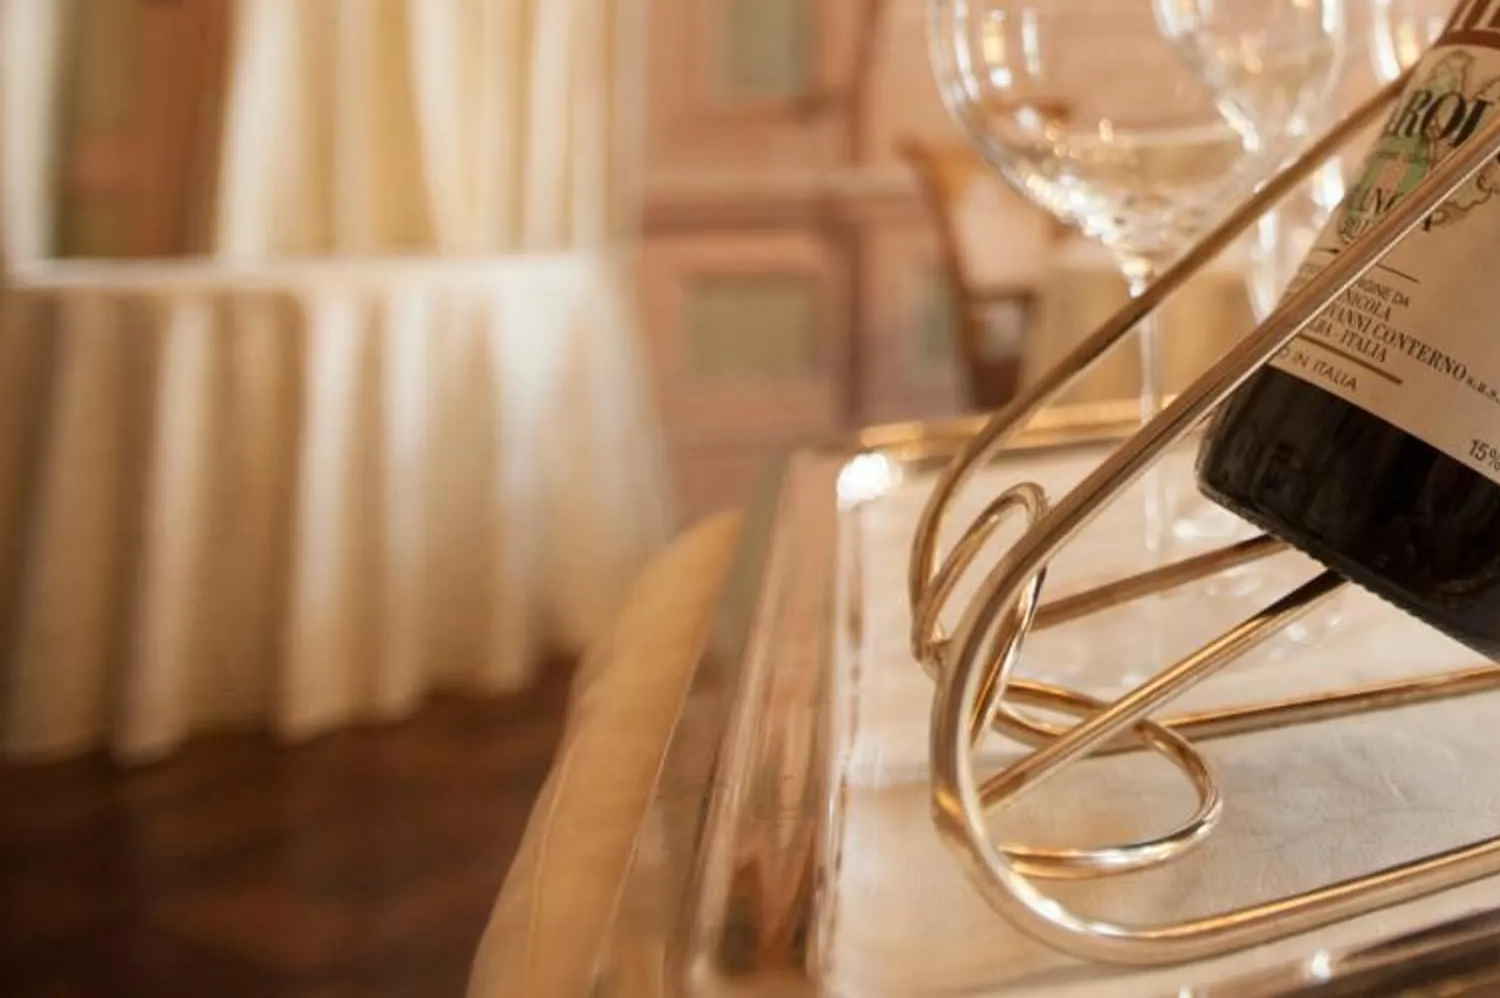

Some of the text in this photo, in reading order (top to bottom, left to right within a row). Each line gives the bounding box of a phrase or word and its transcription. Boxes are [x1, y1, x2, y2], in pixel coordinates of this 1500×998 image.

[1339, 328, 1388, 363] ITALIA
[1372, 321, 1467, 381] CONTERNO
[1312, 359, 1358, 391] ITALIA
